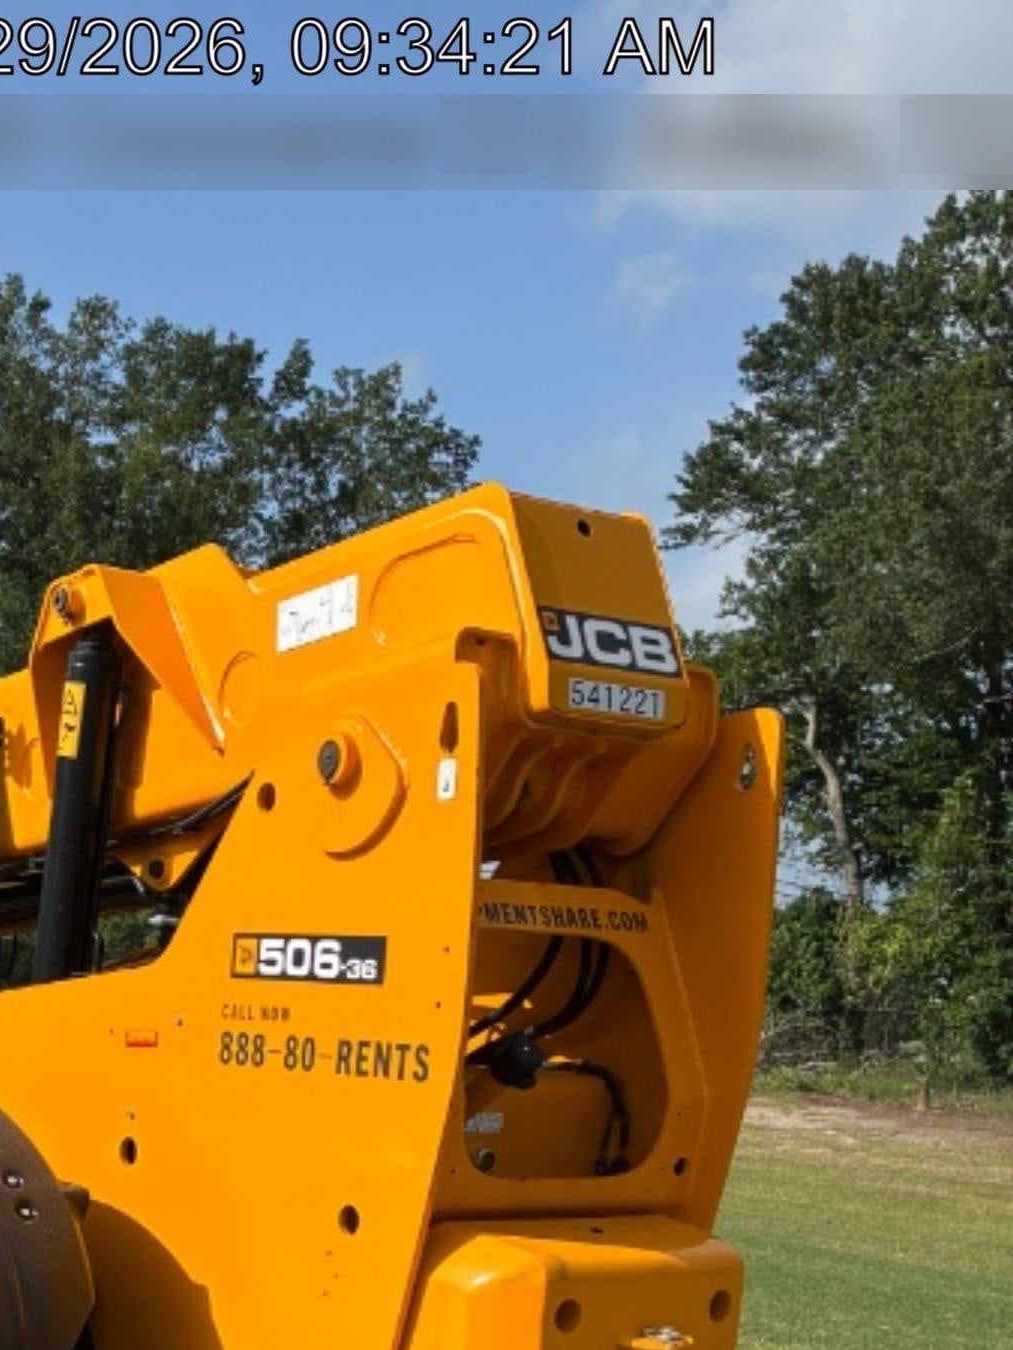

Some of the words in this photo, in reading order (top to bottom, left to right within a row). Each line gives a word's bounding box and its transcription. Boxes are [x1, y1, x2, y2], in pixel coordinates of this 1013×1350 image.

[547, 613, 679, 673] JCB
[571, 680, 659, 718] 541221
[479, 902, 648, 932] MENTSHARE.COM
[221, 1004, 254, 1021] CALL
[260, 1006, 291, 1022] NOW
